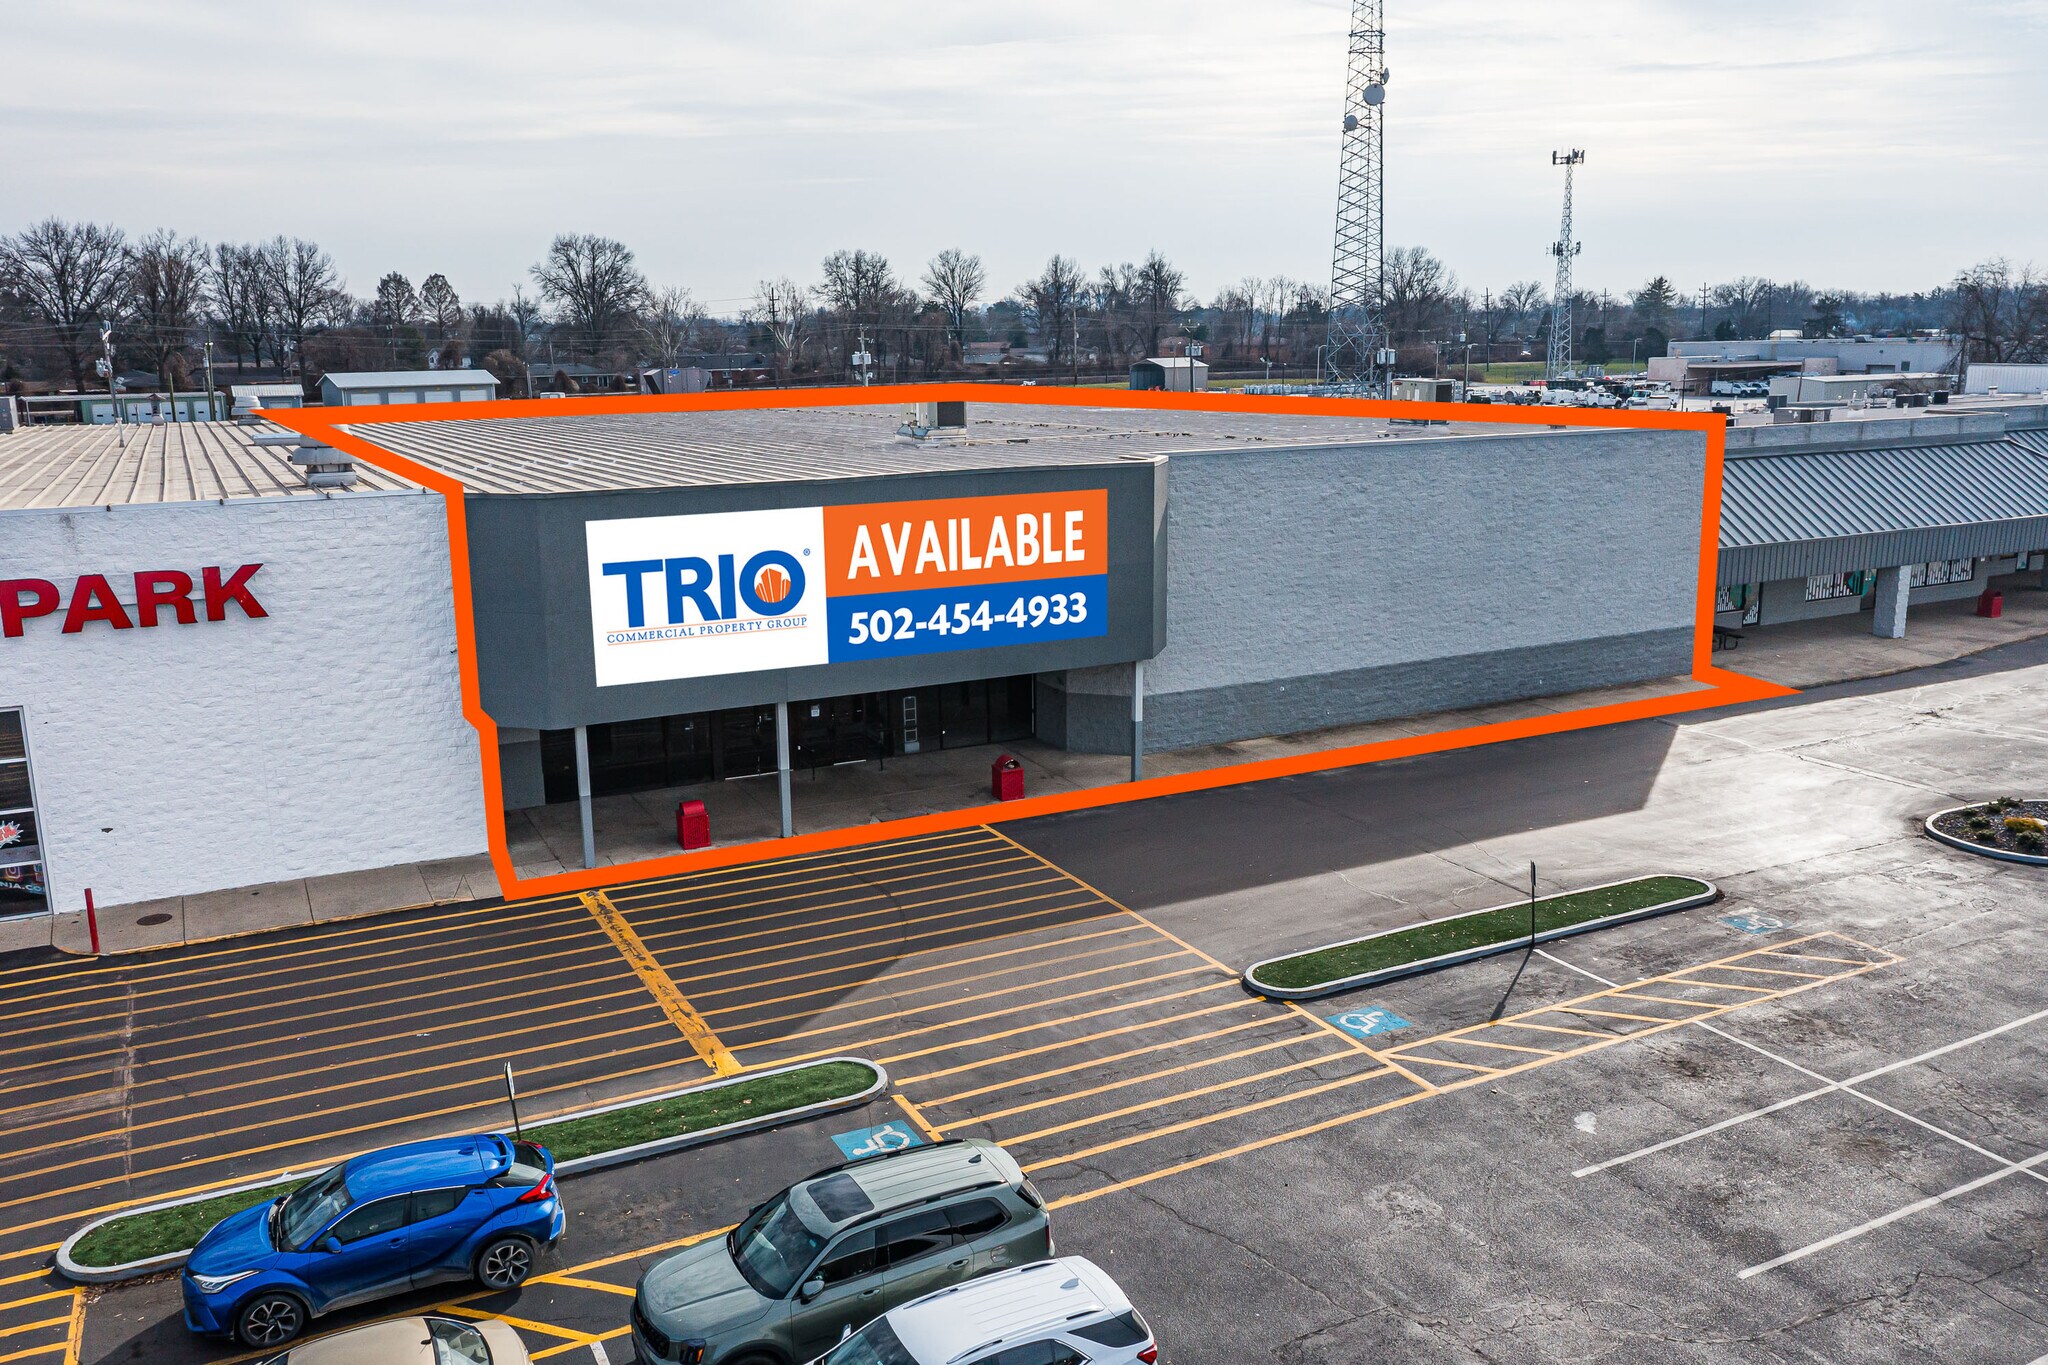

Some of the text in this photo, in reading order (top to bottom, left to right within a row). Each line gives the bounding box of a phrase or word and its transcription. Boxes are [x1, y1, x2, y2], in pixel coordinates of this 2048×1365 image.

[847, 509, 1086, 580] AVAILABLE
[0, 563, 269, 637] PARK
[602, 549, 806, 628] TRIO
[848, 591, 1088, 645] 502-454-4933
[606, 616, 808, 644] COMMERCIAL PROPERTY GROUP
